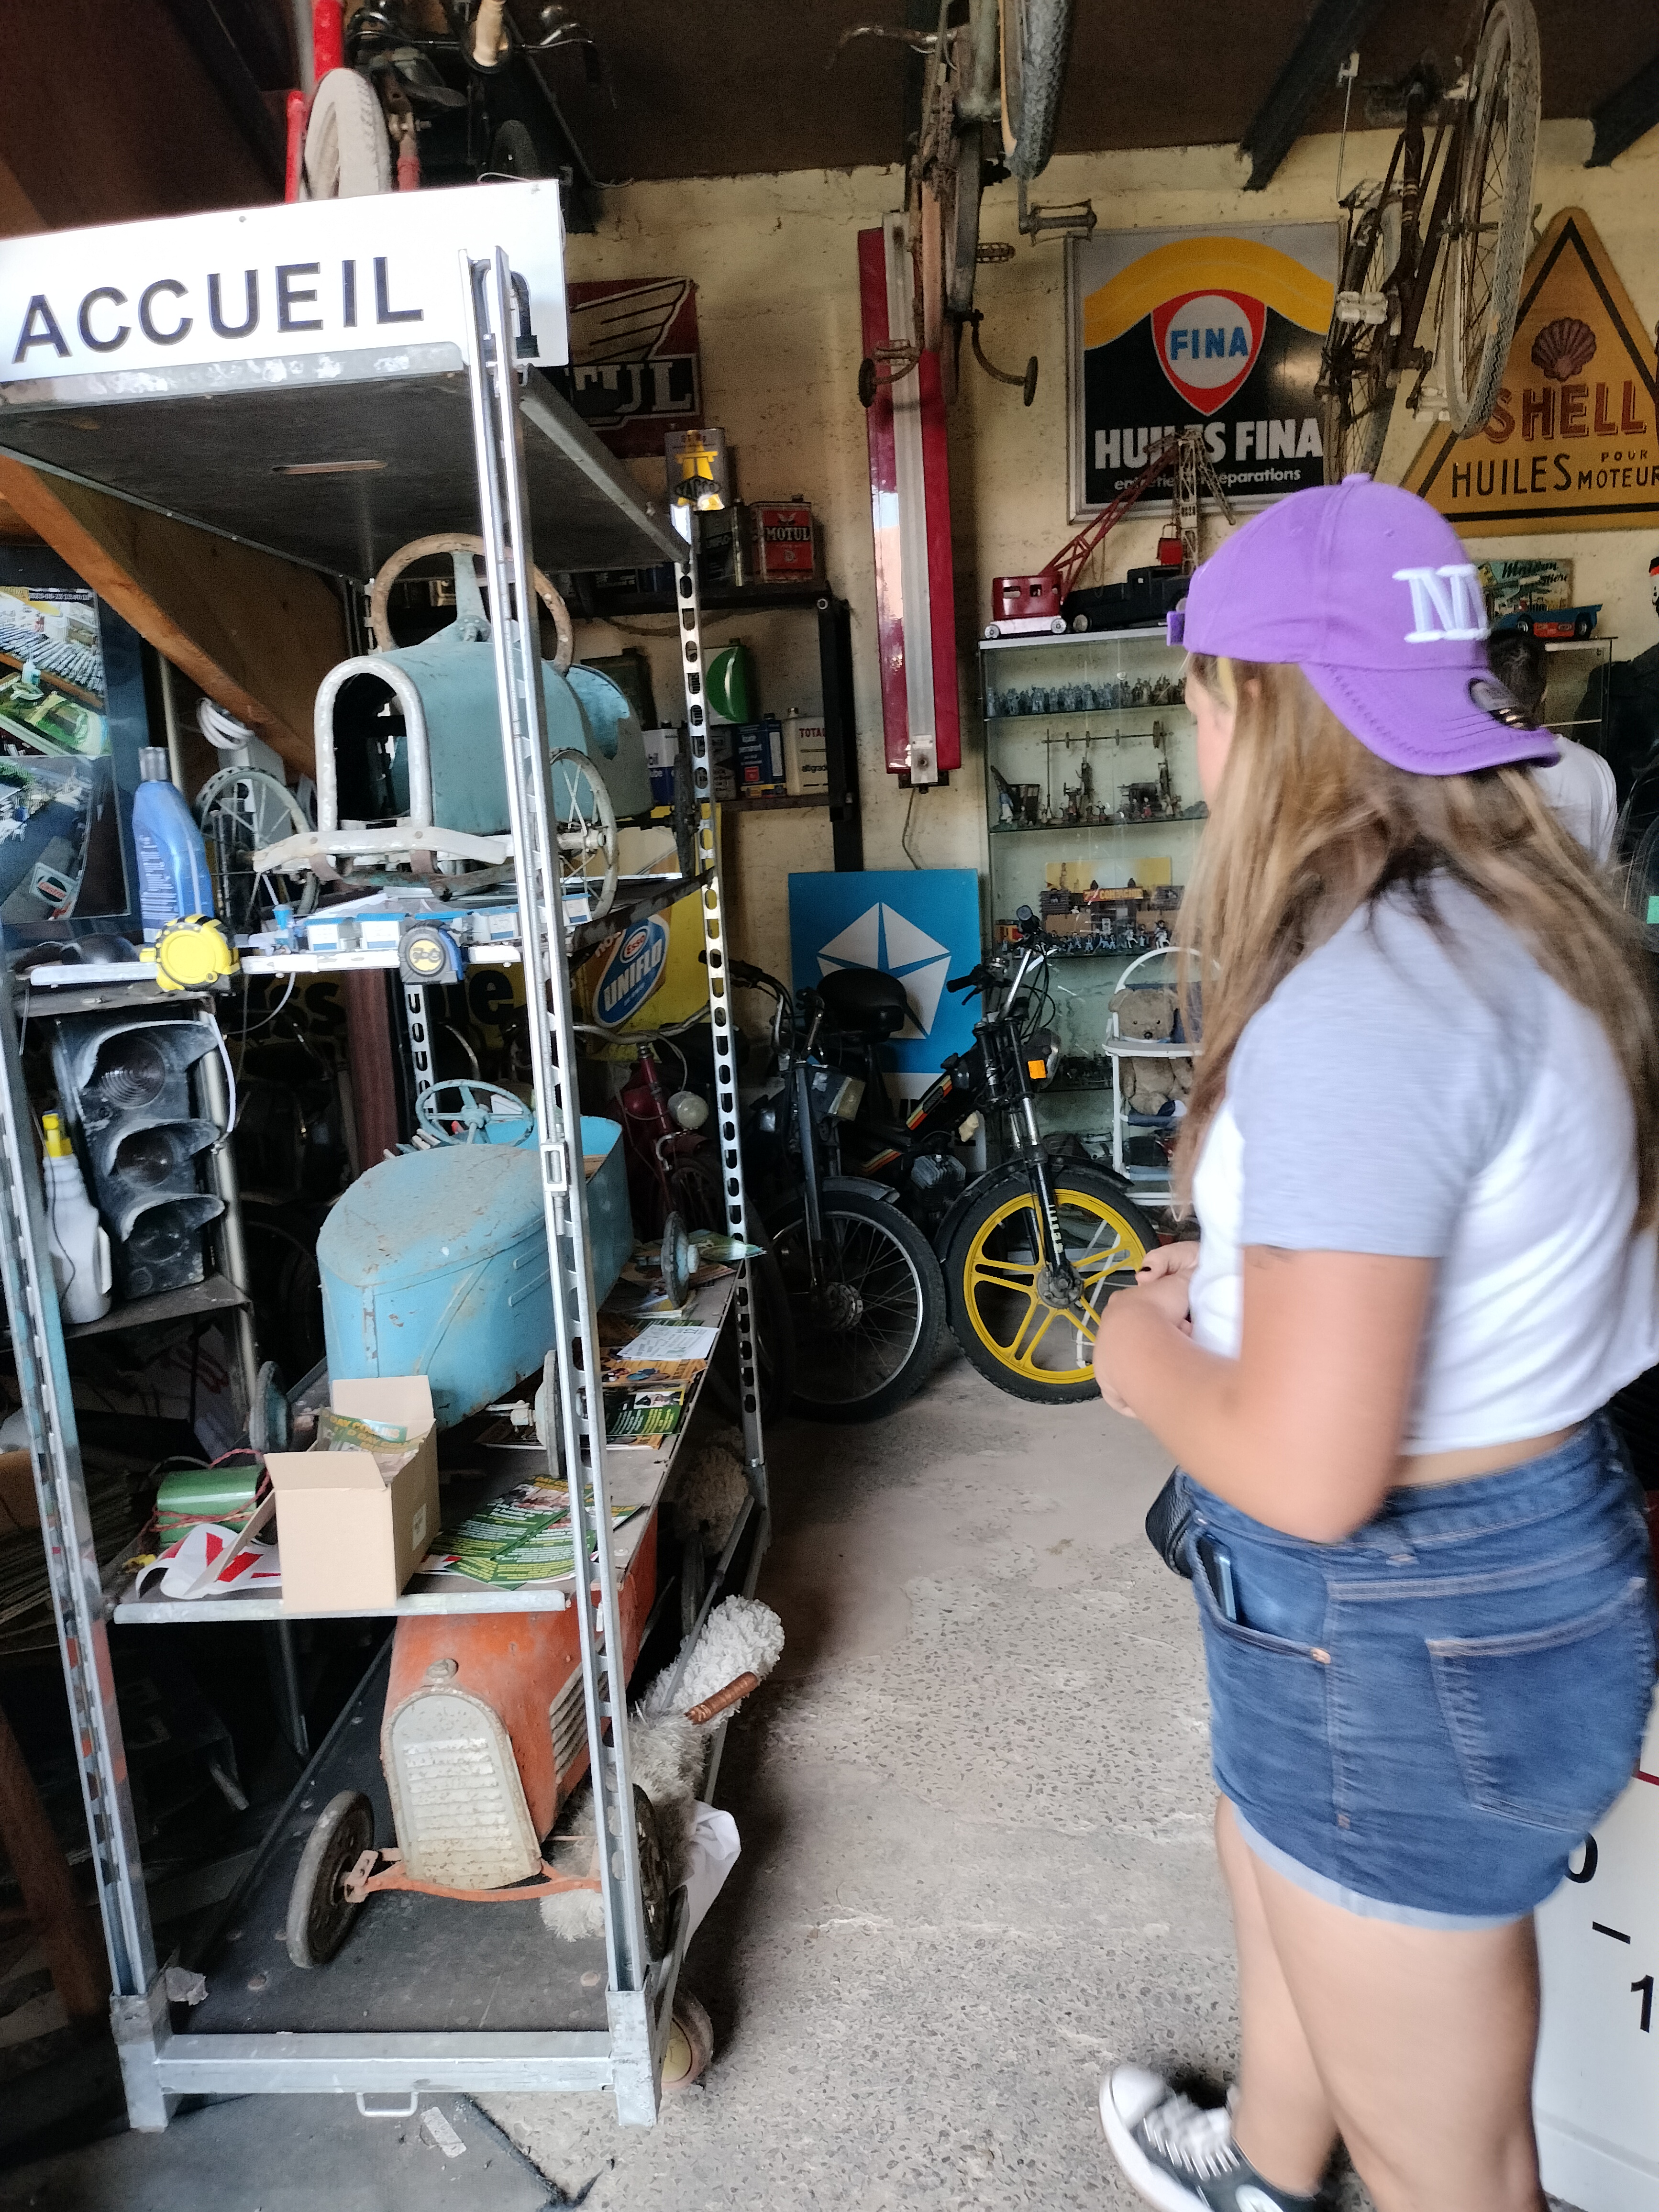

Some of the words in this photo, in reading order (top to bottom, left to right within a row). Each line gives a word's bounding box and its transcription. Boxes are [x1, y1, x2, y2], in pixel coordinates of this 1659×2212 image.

[12, 256, 424, 364] ACCUEIL
[1170, 327, 1249, 361] FINA
[1483, 380, 1647, 444] SHELL
[1095, 422, 1226, 469] HUIS
[1235, 418, 1324, 461] FINA
[1601, 449, 1648, 462] POUR
[1452, 453, 1572, 498] HUILES
[766, 527, 810, 541] MOTUL
[604, 938, 662, 1012] UNIFLO
[1630, 1974, 1654, 2033] 1
